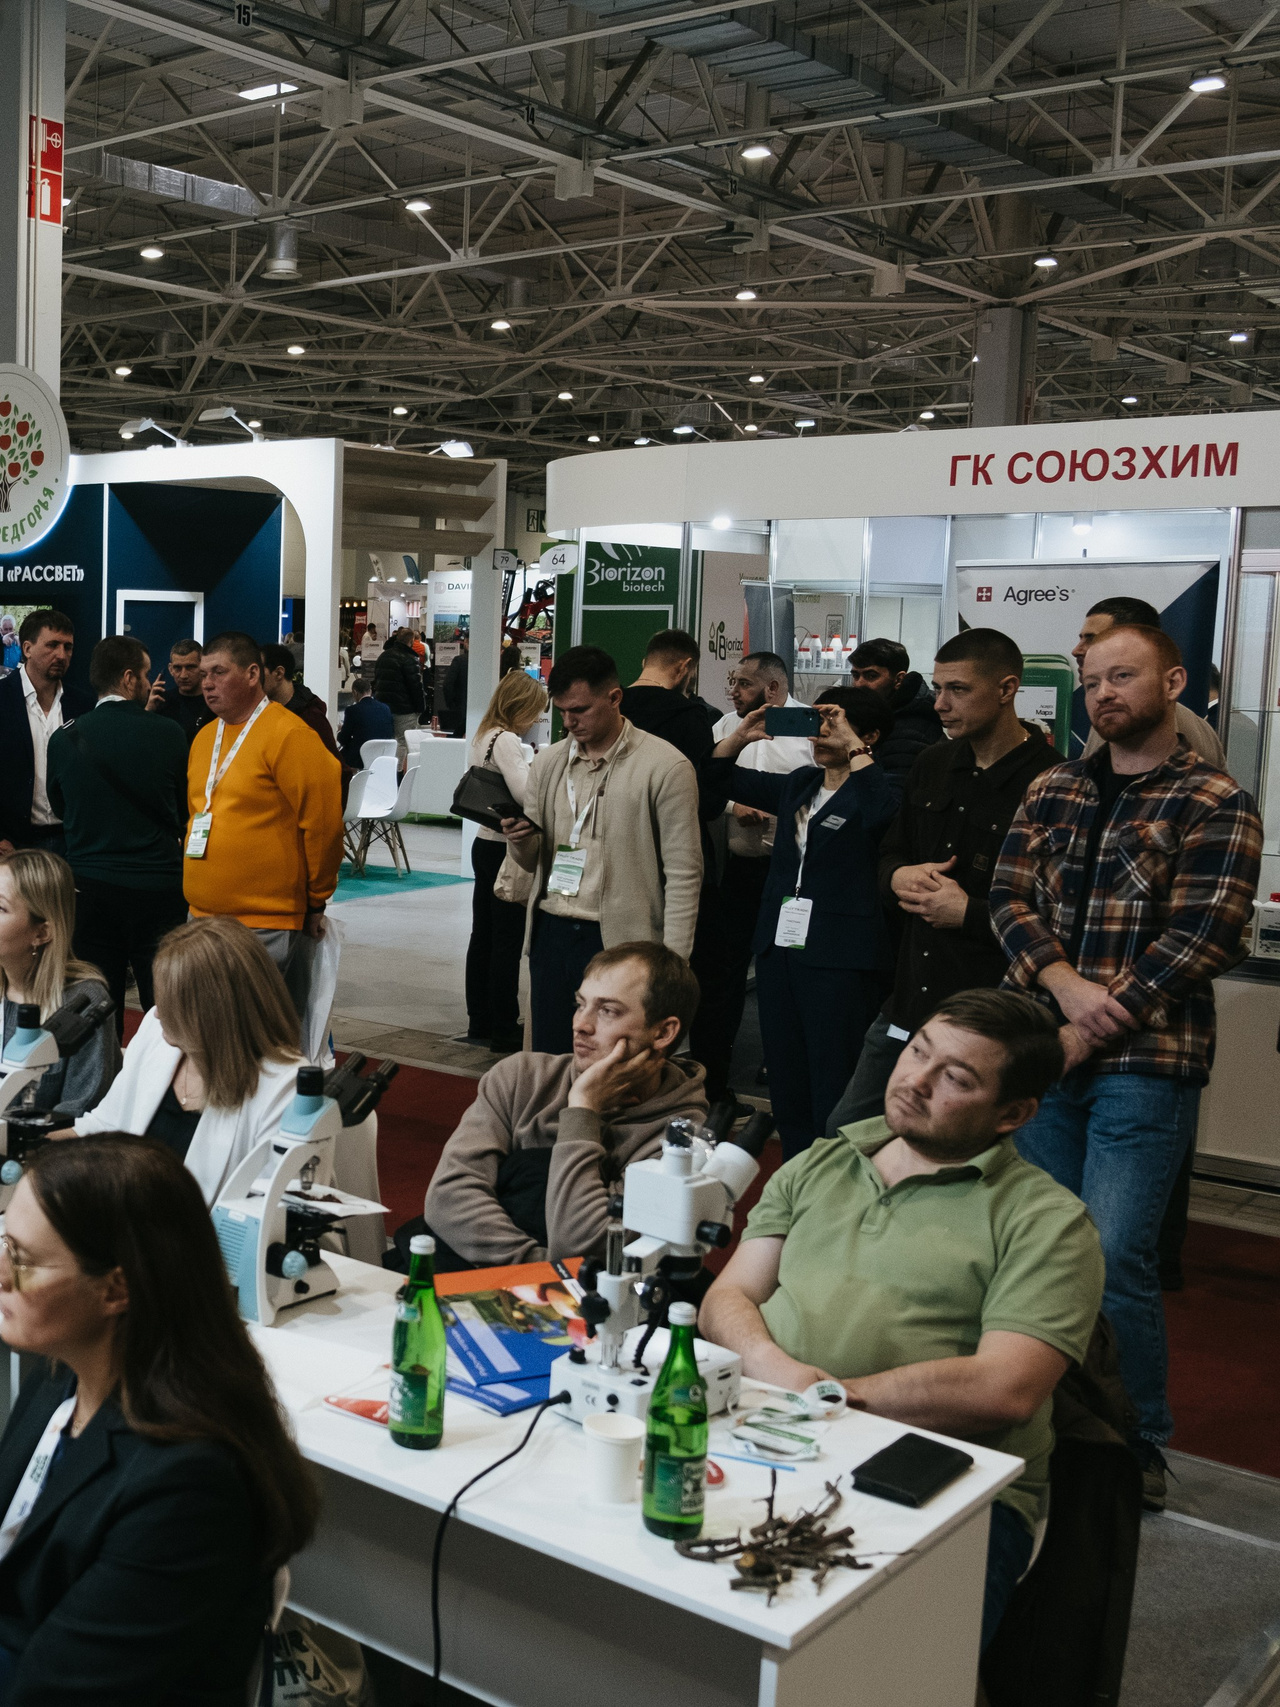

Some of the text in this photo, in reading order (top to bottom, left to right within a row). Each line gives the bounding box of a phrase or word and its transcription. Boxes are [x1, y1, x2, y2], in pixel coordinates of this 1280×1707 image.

[236, 3, 251, 27] 15
[949, 442, 1239, 486] ГК СОЮЗХИМ
[500, 556, 510, 565] 79
[551, 553, 566, 565] 64
[6, 565, 85, 583] «РАССВЕТ»
[622, 580, 665, 593] biotech
